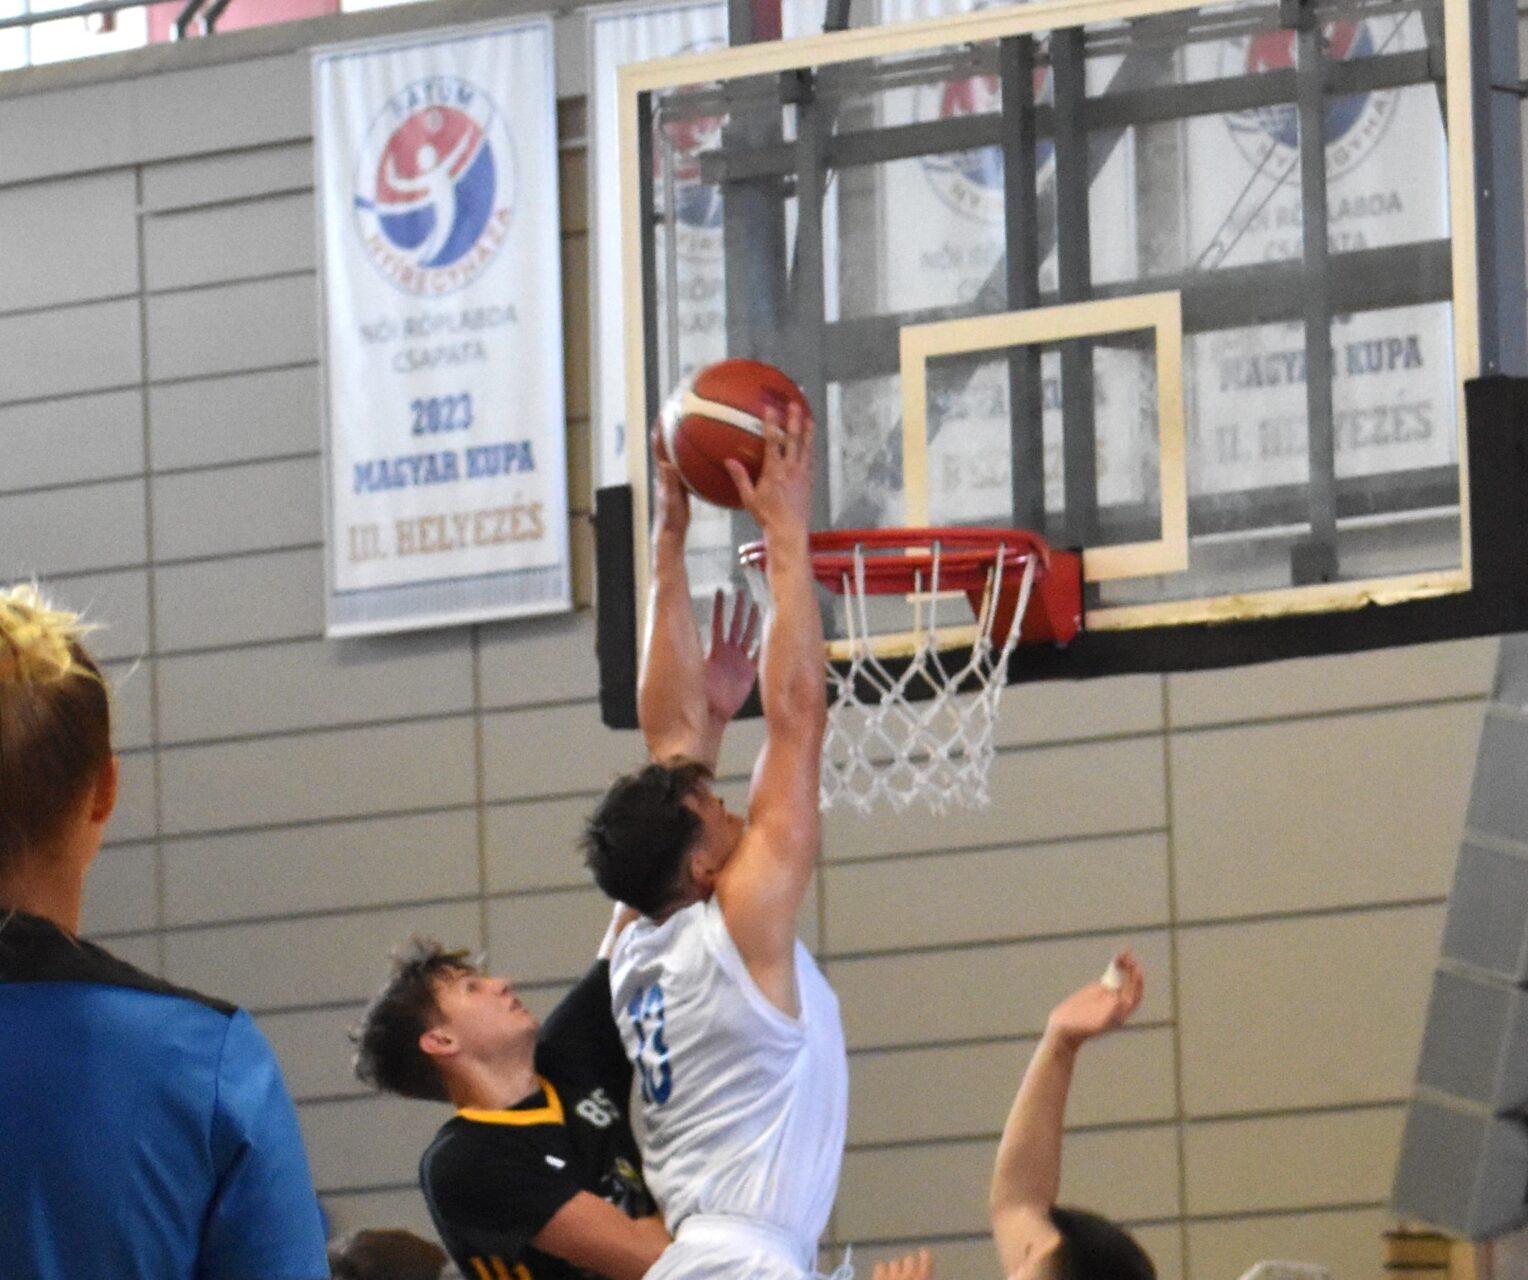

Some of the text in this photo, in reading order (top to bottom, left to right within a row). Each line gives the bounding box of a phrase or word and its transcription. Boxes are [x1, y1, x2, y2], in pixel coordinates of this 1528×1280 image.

[1346, 334, 1423, 376] KUPA
[410, 391, 474, 437] 2023
[353, 440, 536, 495] MAGYAR KUPA
[395, 491, 546, 557] HELYEZÉS
